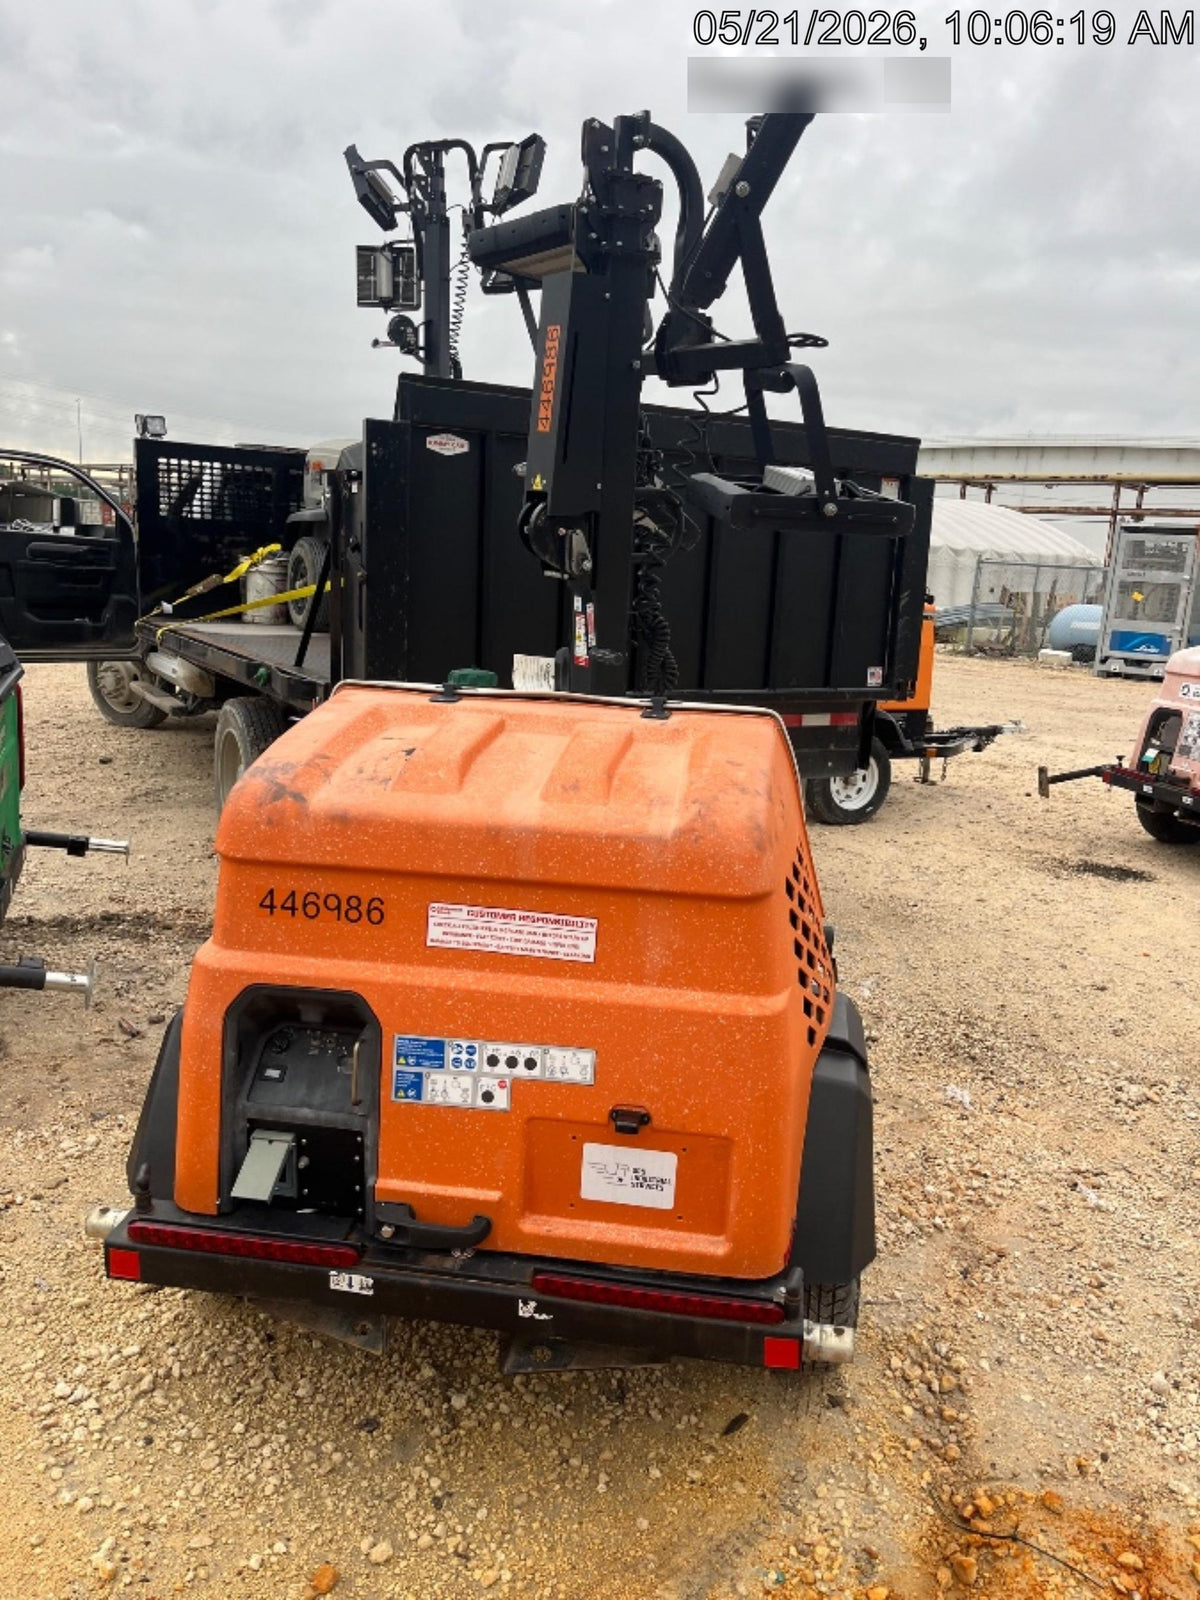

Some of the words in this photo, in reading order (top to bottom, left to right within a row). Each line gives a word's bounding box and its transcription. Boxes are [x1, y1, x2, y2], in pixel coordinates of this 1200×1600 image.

[538, 327, 559, 430] 446986
[258, 887, 385, 925] 446986
[466, 909, 517, 921] CUSTOMER
